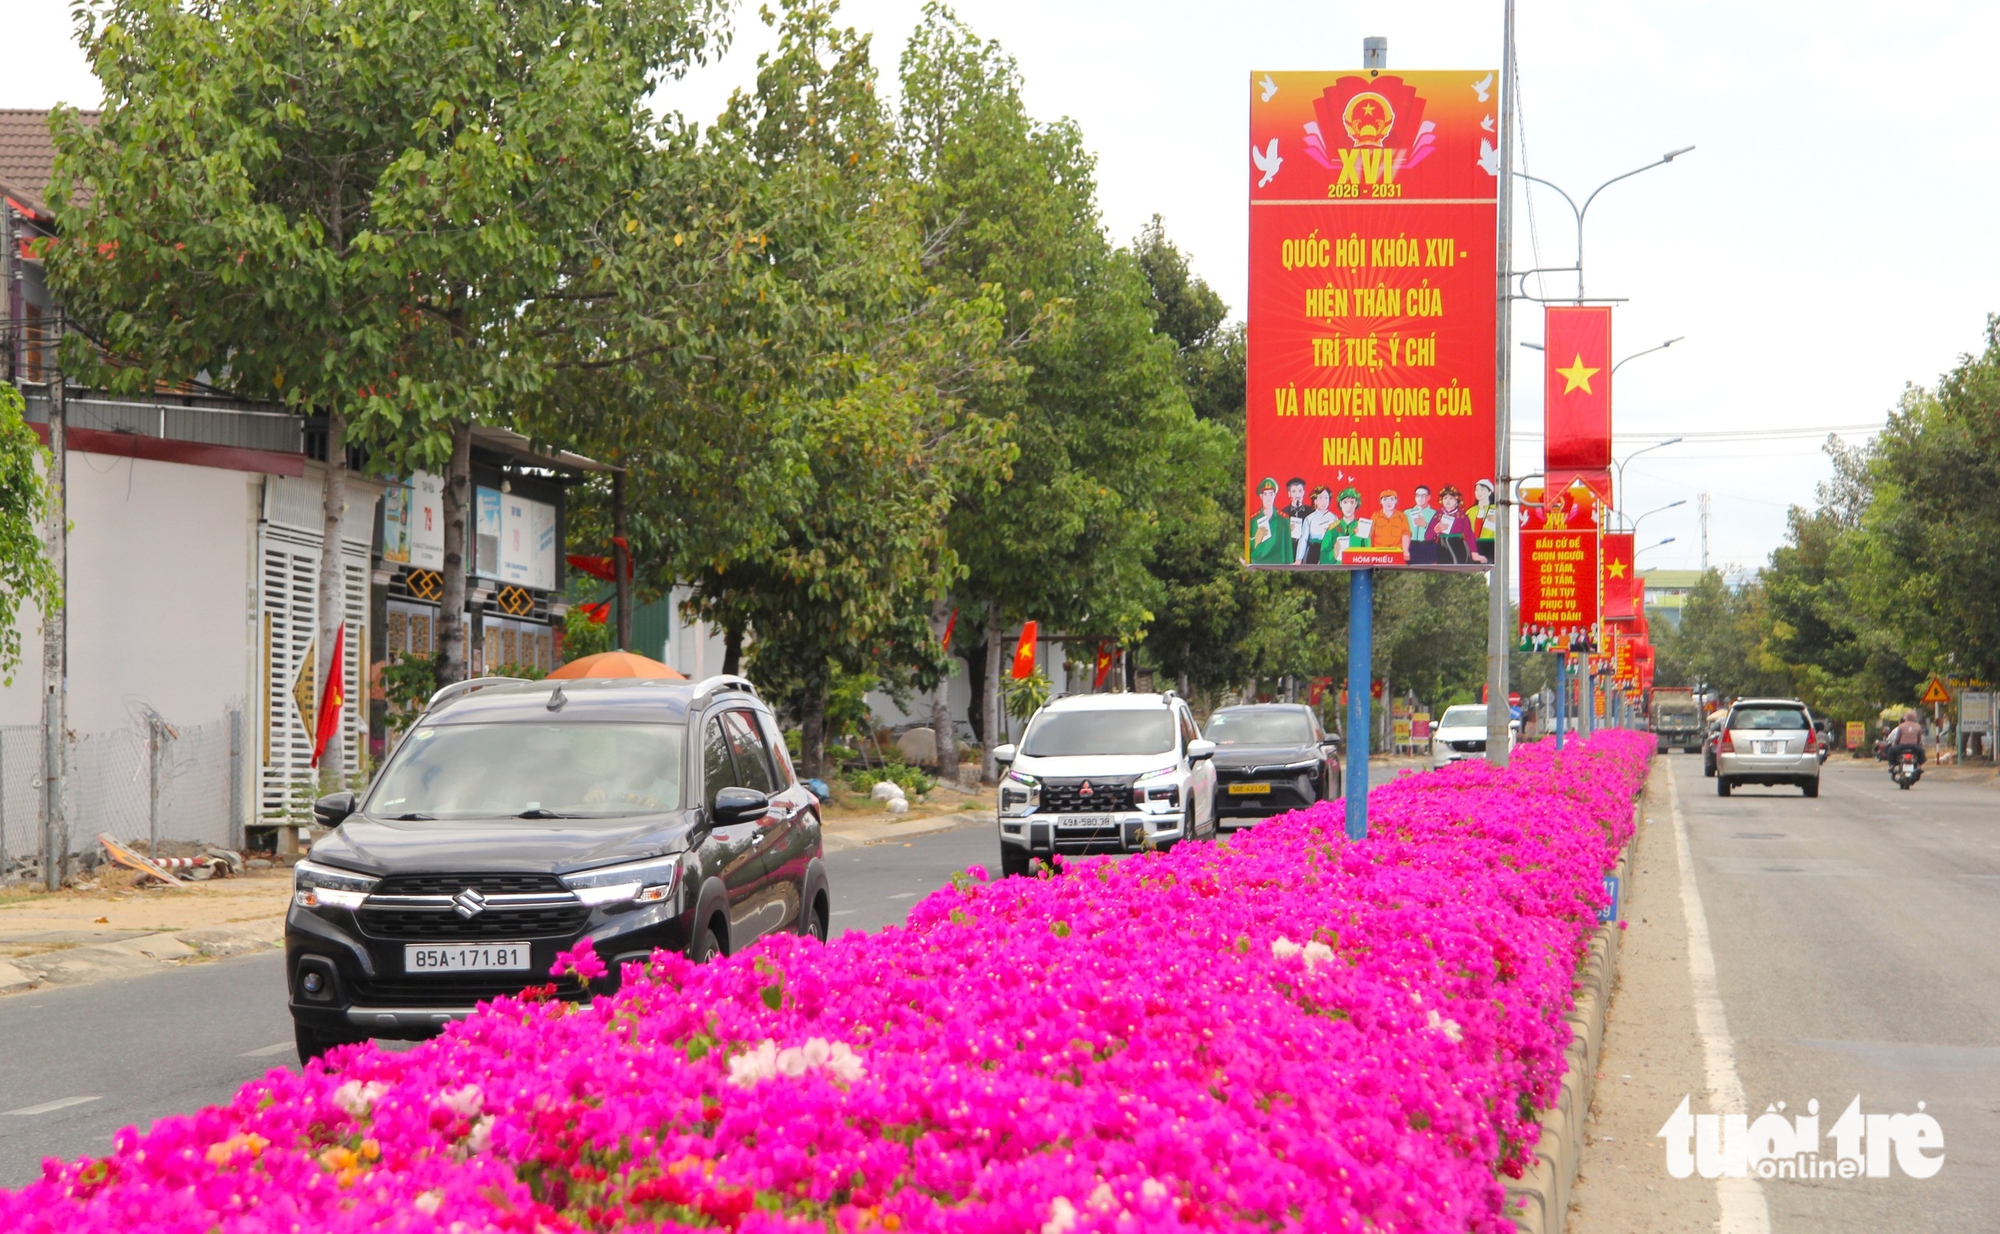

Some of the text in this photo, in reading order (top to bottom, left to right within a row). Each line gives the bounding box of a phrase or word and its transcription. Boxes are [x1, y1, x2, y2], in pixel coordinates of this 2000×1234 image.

[1337, 148, 1395, 184] XVI
[1328, 184, 1359, 198] 2026
[1372, 184, 1402, 198] 2031
[1282, 229, 1330, 271] QUỐC
[1336, 233, 1366, 274] HỘI
[1372, 233, 1420, 267] KHÓA
[1425, 239, 1455, 267] XVI
[1306, 278, 1443, 324] HIỆN THÂN CỦA
[1312, 332, 1436, 373] TRÍ TUỆ, Ý CHÍ
[1275, 378, 1473, 422] VÀ NGUYỆN VỌNG CỦA
[1323, 432, 1423, 466] NHÂN DÂN!
[1352, 554, 1393, 563] HÒM PHIẾU
[1532, 551, 1555, 563] CHỌN
[1541, 562, 1552, 573] CÓ
[1541, 574, 1552, 585] CÓ
[1541, 586, 1558, 598] TẬN
[1540, 600, 1576, 610] PHỤC VỤ
[1534, 611, 1559, 621] NHÂN
[416, 949, 517, 967] 85A-171.81
